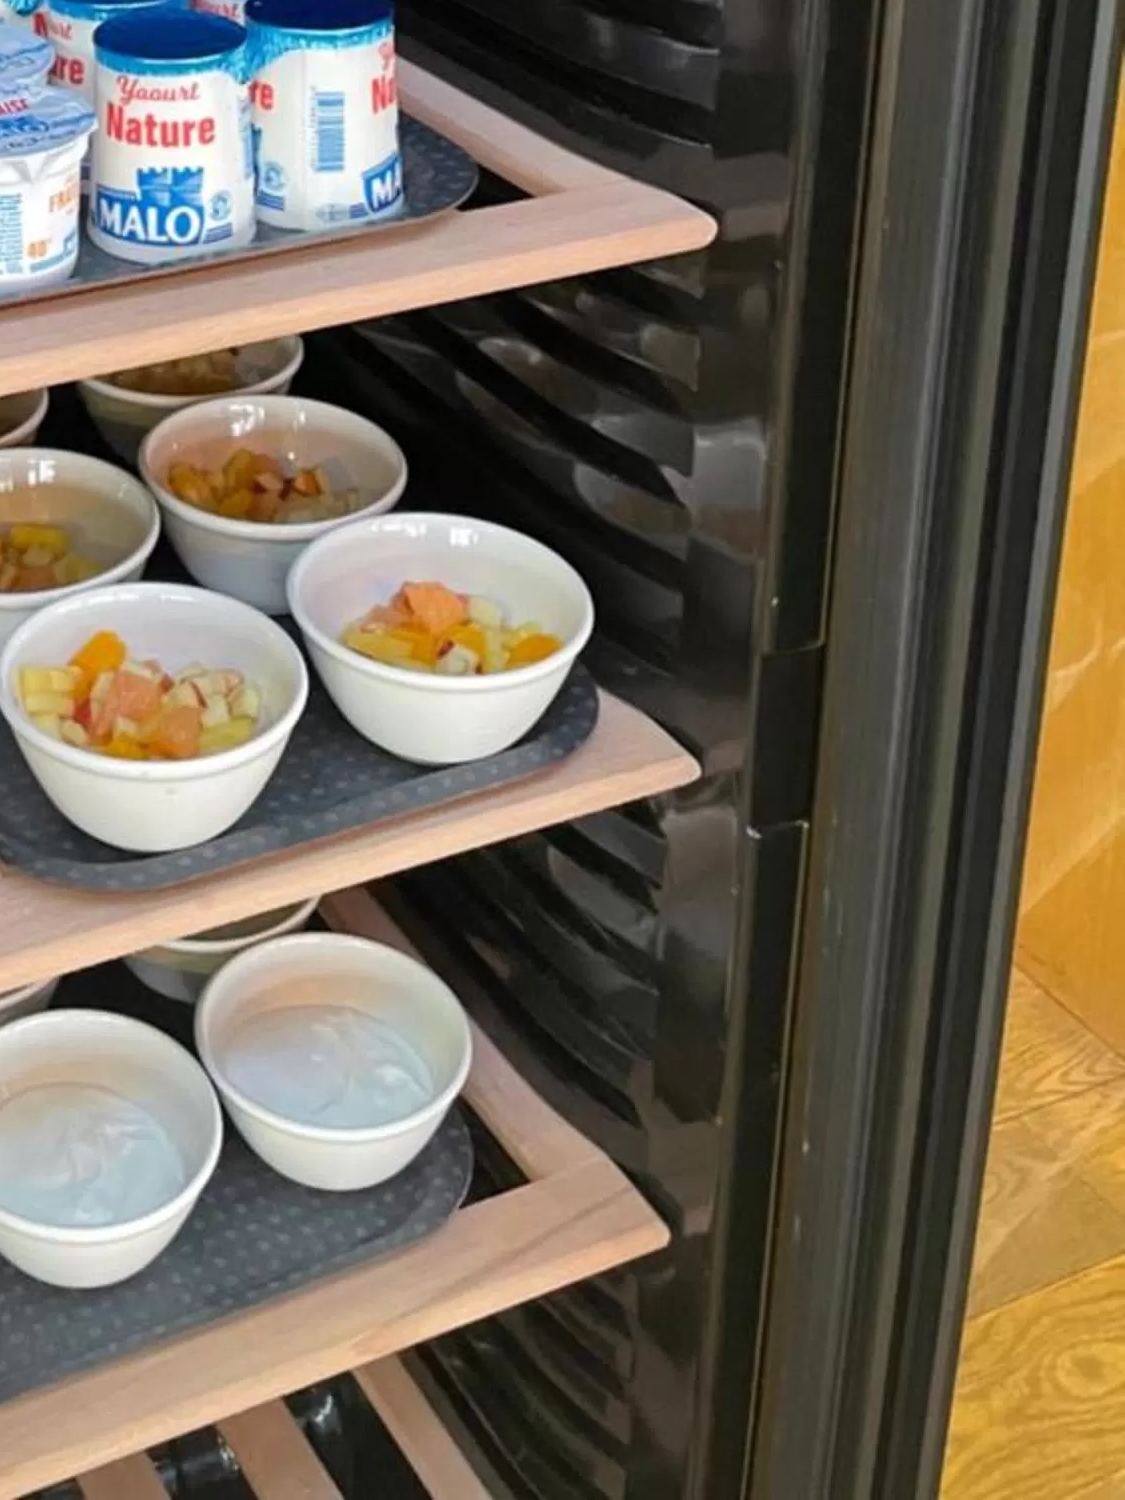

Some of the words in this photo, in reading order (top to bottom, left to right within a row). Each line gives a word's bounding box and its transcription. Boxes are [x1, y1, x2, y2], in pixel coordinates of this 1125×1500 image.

[116, 75, 201, 104] Yaourt
[106, 101, 216, 148] Nature
[98, 197, 201, 244] MALO
